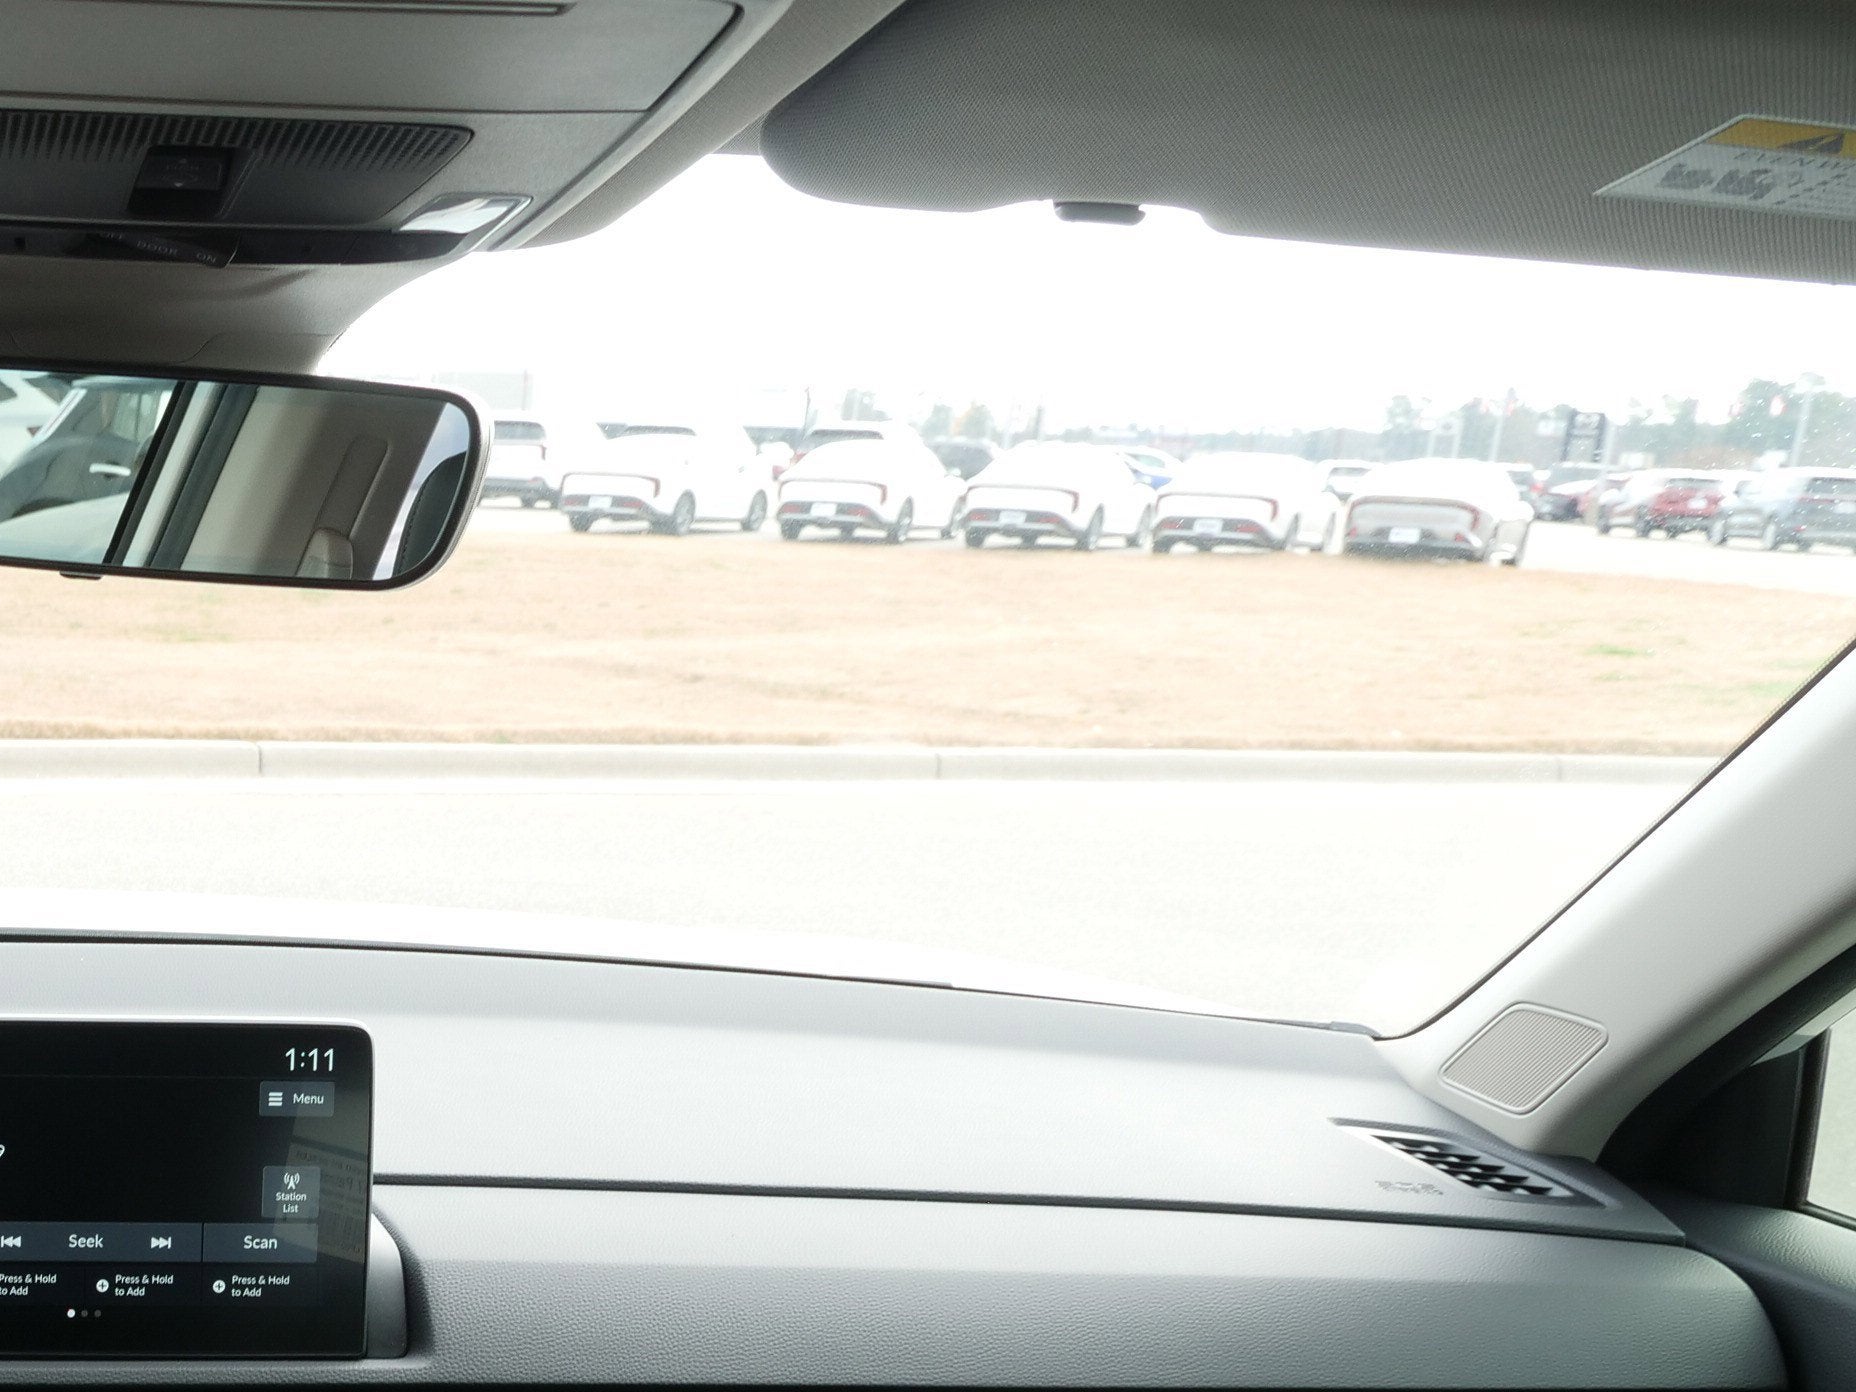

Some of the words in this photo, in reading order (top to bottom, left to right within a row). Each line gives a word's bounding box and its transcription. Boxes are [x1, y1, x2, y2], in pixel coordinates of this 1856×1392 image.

[284, 1047, 335, 1072] 1:11
[292, 1093, 325, 1105] Menu
[275, 1191, 307, 1201] Station
[283, 1203, 299, 1214] List
[68, 1233, 104, 1249] Seek
[243, 1234, 278, 1250] Scan
[25, 1274, 33, 1283] &
[35, 1274, 57, 1284] Hold
[116, 1275, 140, 1285] Press
[142, 1275, 150, 1284] &
[153, 1275, 174, 1285] Hold
[10, 1286, 28, 1296] Add
[116, 1288, 125, 1297] to
[128, 1287, 146, 1297] Add
